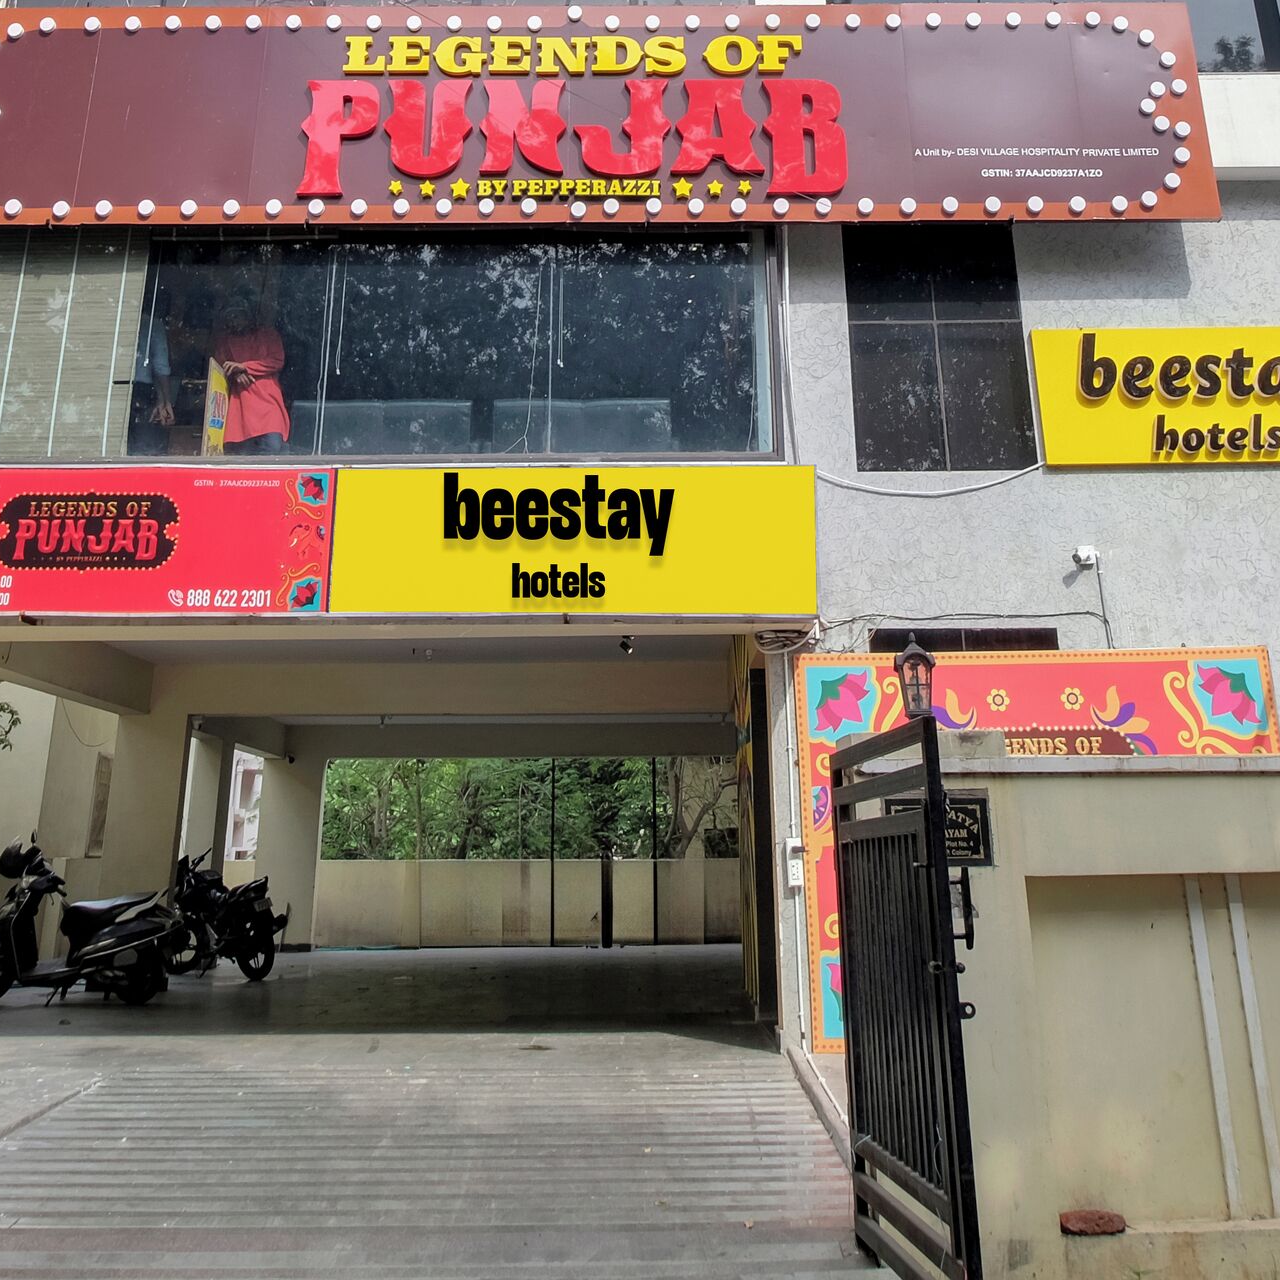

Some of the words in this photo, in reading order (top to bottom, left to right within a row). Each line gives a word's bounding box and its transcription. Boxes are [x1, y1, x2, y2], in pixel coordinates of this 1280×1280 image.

[343, 34, 686, 76] LEGENDS
[701, 34, 803, 76] OF
[295, 78, 850, 198] PUNJAB
[914, 148, 922, 157] A
[923, 148, 940, 157] Unit
[957, 147, 979, 156] DESI
[980, 147, 1020, 156] VILLAGE
[1021, 147, 1080, 157] HOSPITALITY
[1082, 148, 1121, 157] PRIVATE
[1122, 147, 1160, 157] LIMITED
[981, 168, 1013, 178] GSTIN:
[477, 179, 509, 198] BY
[511, 179, 662, 198] PEPPERAZZI
[28, 501, 118, 517] LEGENDS
[125, 501, 152, 517] OF
[443, 471, 676, 557] beestay
[12, 519, 159, 561] PUNJAB
[511, 563, 606, 599] hotels
[186, 589, 211, 607] 888
[214, 589, 238, 607] 622
[240, 589, 271, 607] 2301
[1005, 737, 1068, 755] GENDS
[1075, 736, 1102, 754] OF
[946, 810, 979, 834] ATYA
